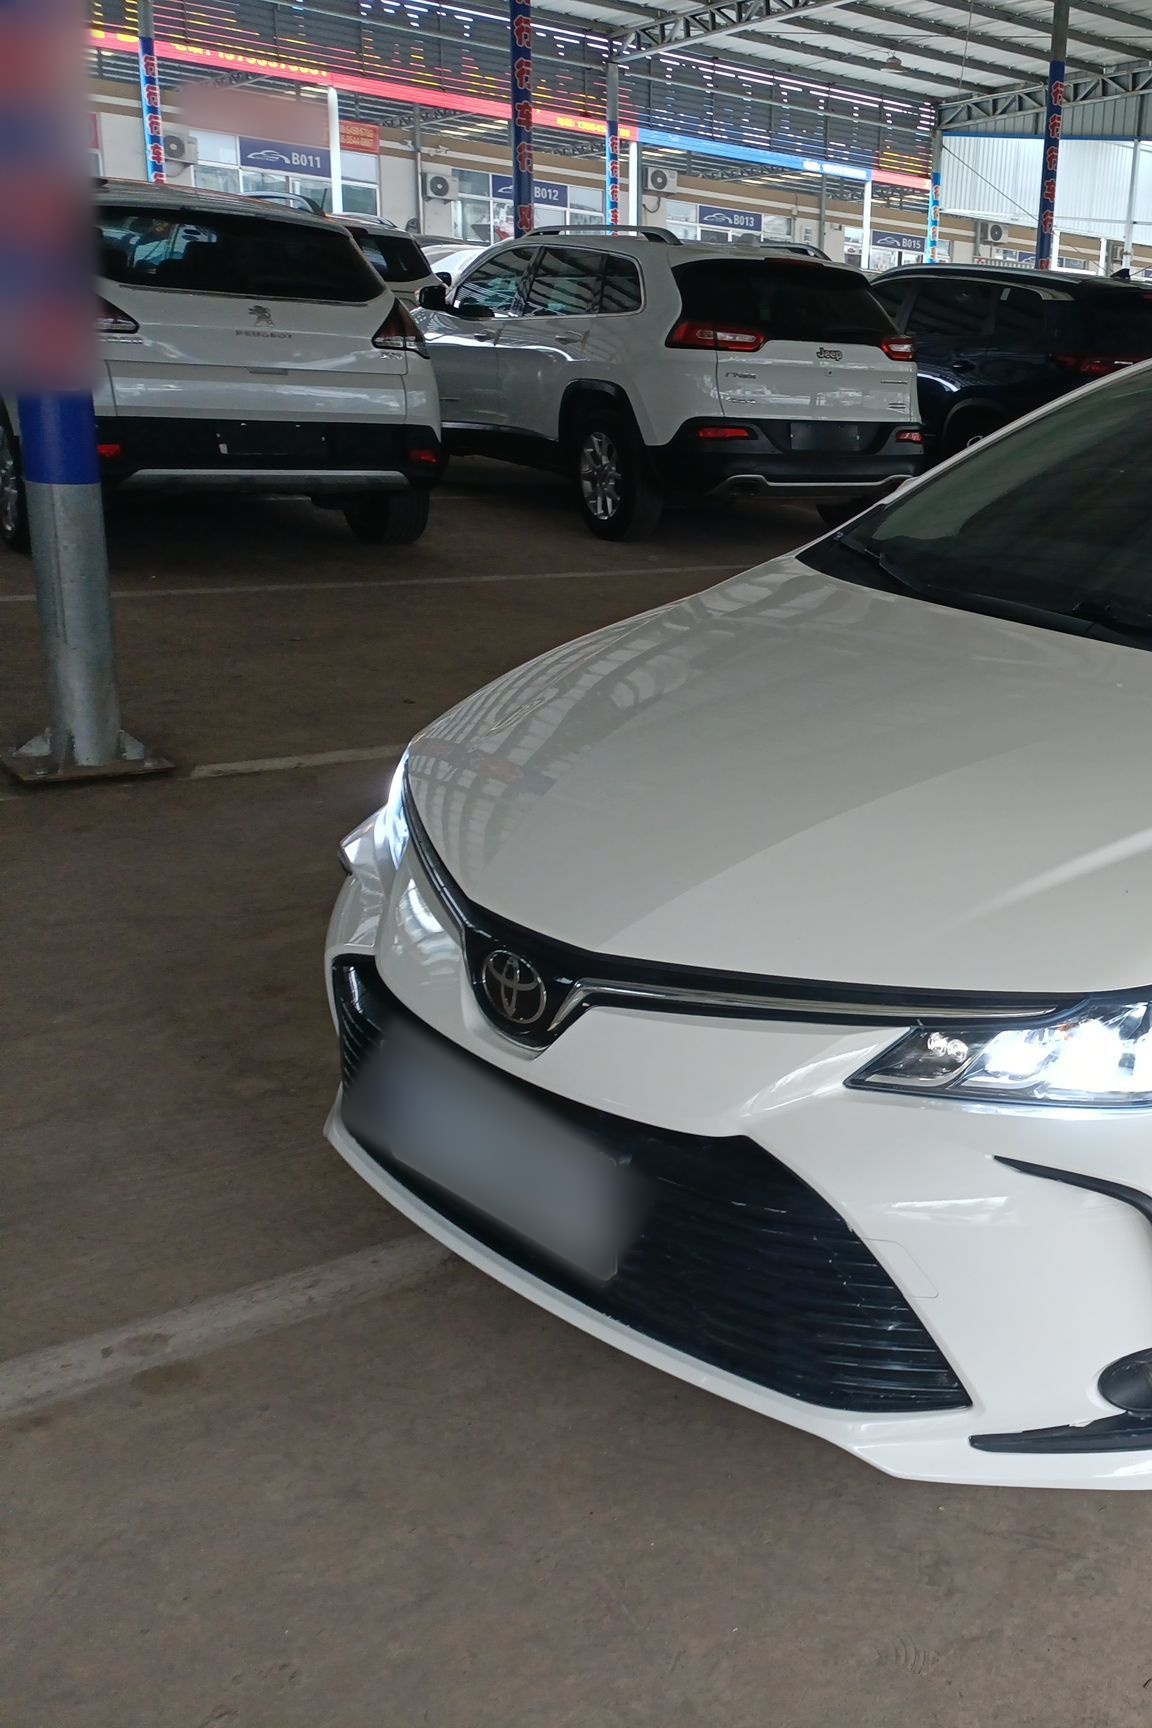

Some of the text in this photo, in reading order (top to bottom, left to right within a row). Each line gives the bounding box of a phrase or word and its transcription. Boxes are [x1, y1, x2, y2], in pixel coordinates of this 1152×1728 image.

[291, 152, 321, 168] B011
[534, 186, 559, 201] B012
[733, 214, 755, 227] B013
[901, 238, 921, 249] B015
[235, 329, 294, 339] PEUGEOT
[816, 347, 843, 361] Jeep
